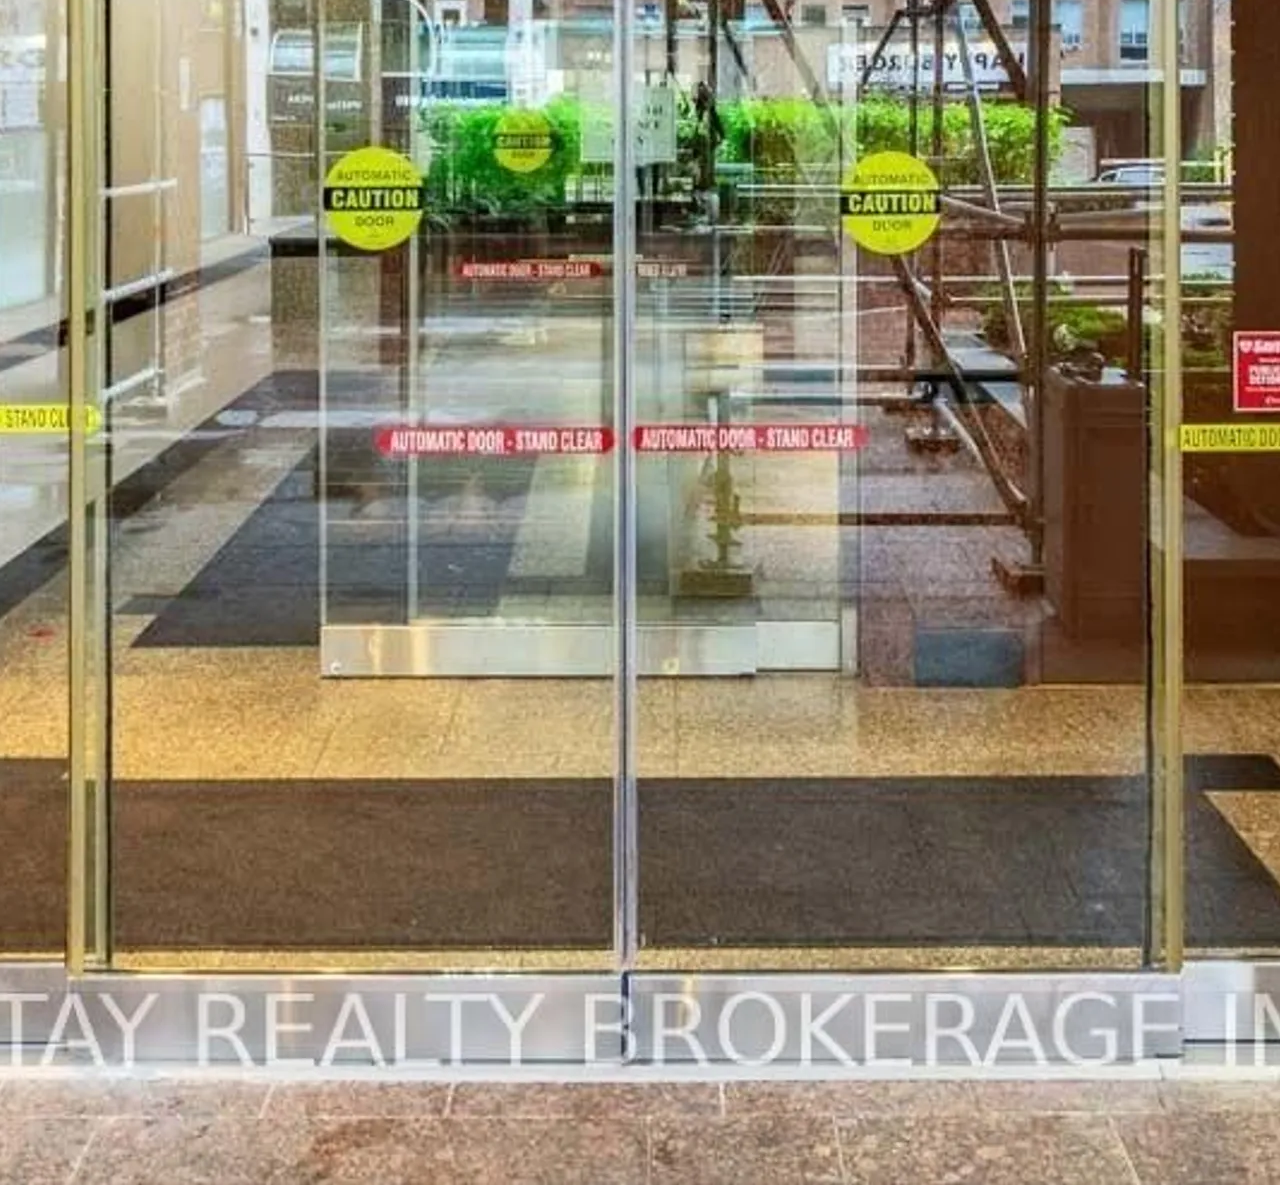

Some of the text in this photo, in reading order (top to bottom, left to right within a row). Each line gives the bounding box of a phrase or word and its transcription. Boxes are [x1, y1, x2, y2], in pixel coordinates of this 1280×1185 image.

[337, 169, 412, 181] AUTOMATIC
[853, 173, 930, 184] AUTOMATIC
[331, 189, 419, 208] CAUTION
[848, 193, 936, 212] CAUTION
[354, 215, 395, 227] DOOR
[872, 220, 912, 231] DOOR
[6, 408, 45, 428] STAND
[390, 430, 465, 452] AUTOMATIC
[467, 430, 505, 453] DOOR
[515, 430, 558, 451] STAND
[560, 430, 602, 451] CLEAR
[640, 428, 716, 449] AUTOMATIC
[719, 428, 756, 448] DOOR
[766, 428, 809, 448] STAND
[812, 427, 854, 448] CLEAR
[1182, 427, 1255, 448] AUTOMATIC
